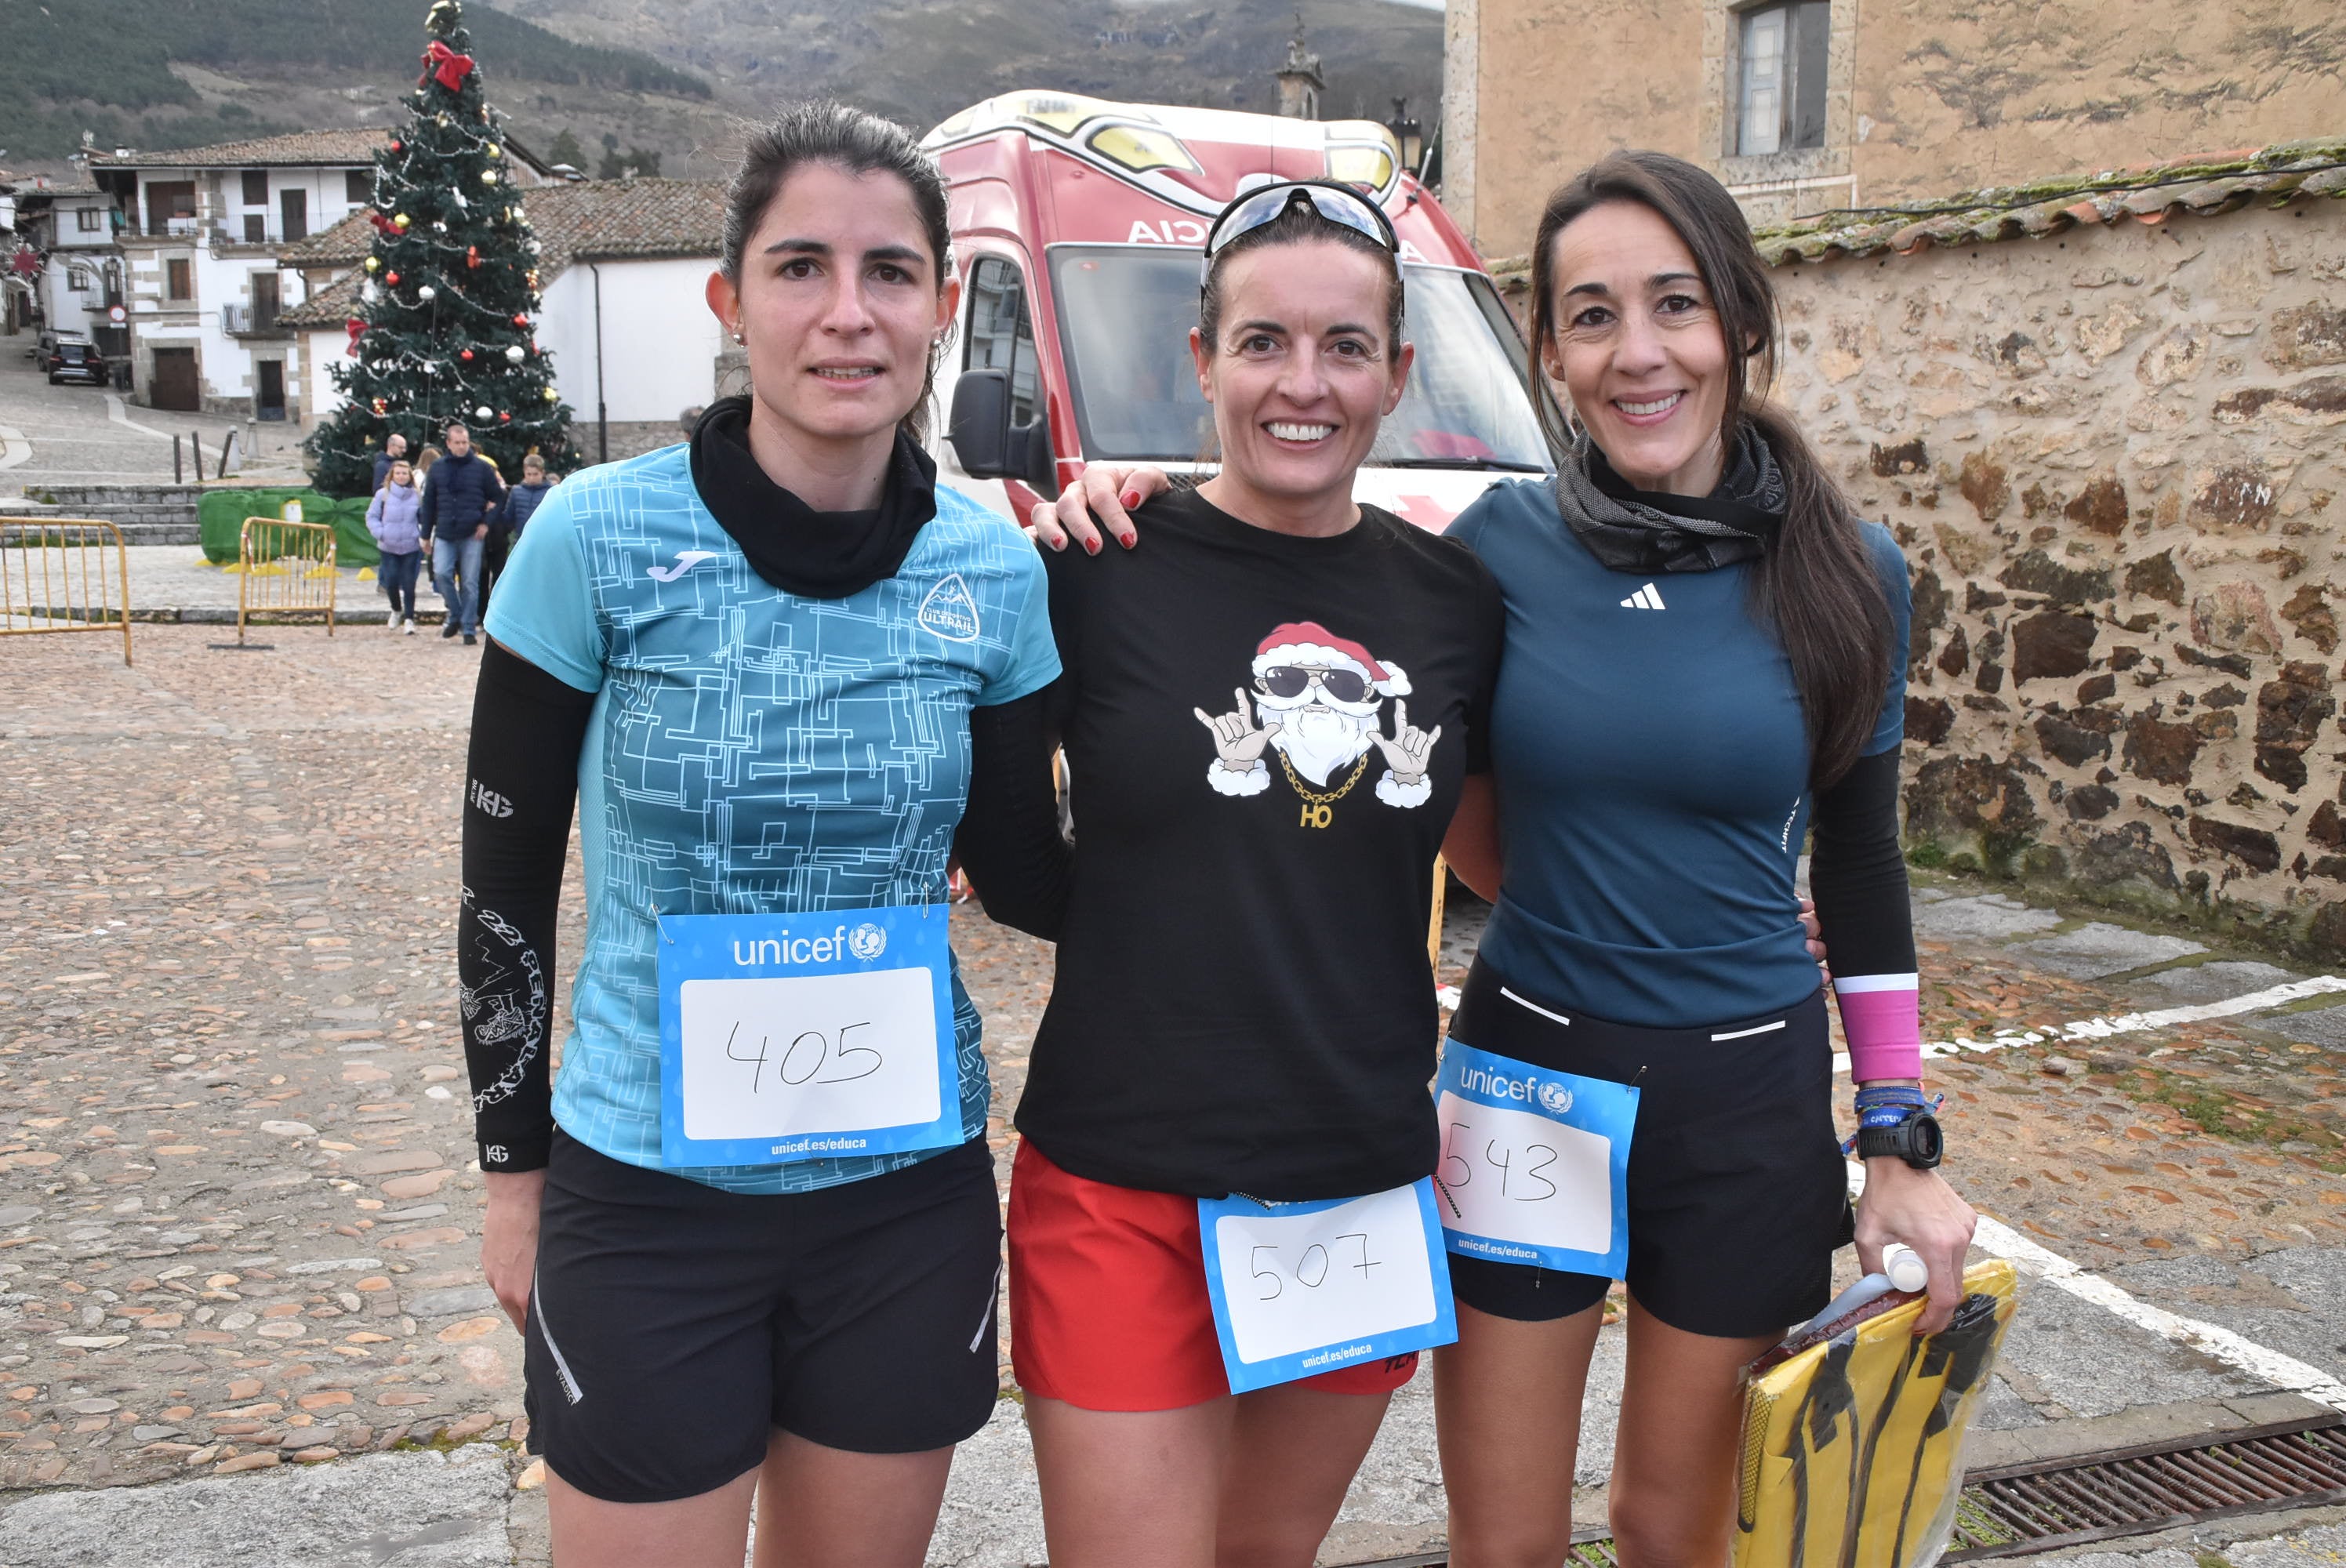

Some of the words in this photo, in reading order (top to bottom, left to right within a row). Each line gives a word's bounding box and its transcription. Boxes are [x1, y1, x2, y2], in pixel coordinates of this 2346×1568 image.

[924, 612, 975, 633] ULTRAIL
[941, 611, 971, 622] DEPORTIVO
[1300, 804, 1332, 829] HO
[1781, 808, 1796, 854] TECHFIT
[733, 925, 846, 965] unicef
[726, 1022, 883, 1094] 405
[1461, 1066, 1537, 1103] unicef
[771, 1138, 866, 1156] unicef.es/educa
[1446, 1122, 1558, 1201] 543
[1251, 1233, 1382, 1301] 507
[1458, 1239, 1538, 1259] unicef.es/educa
[1302, 1343, 1372, 1369] unicef.es/educa
[555, 1368, 577, 1406] EVADICT
